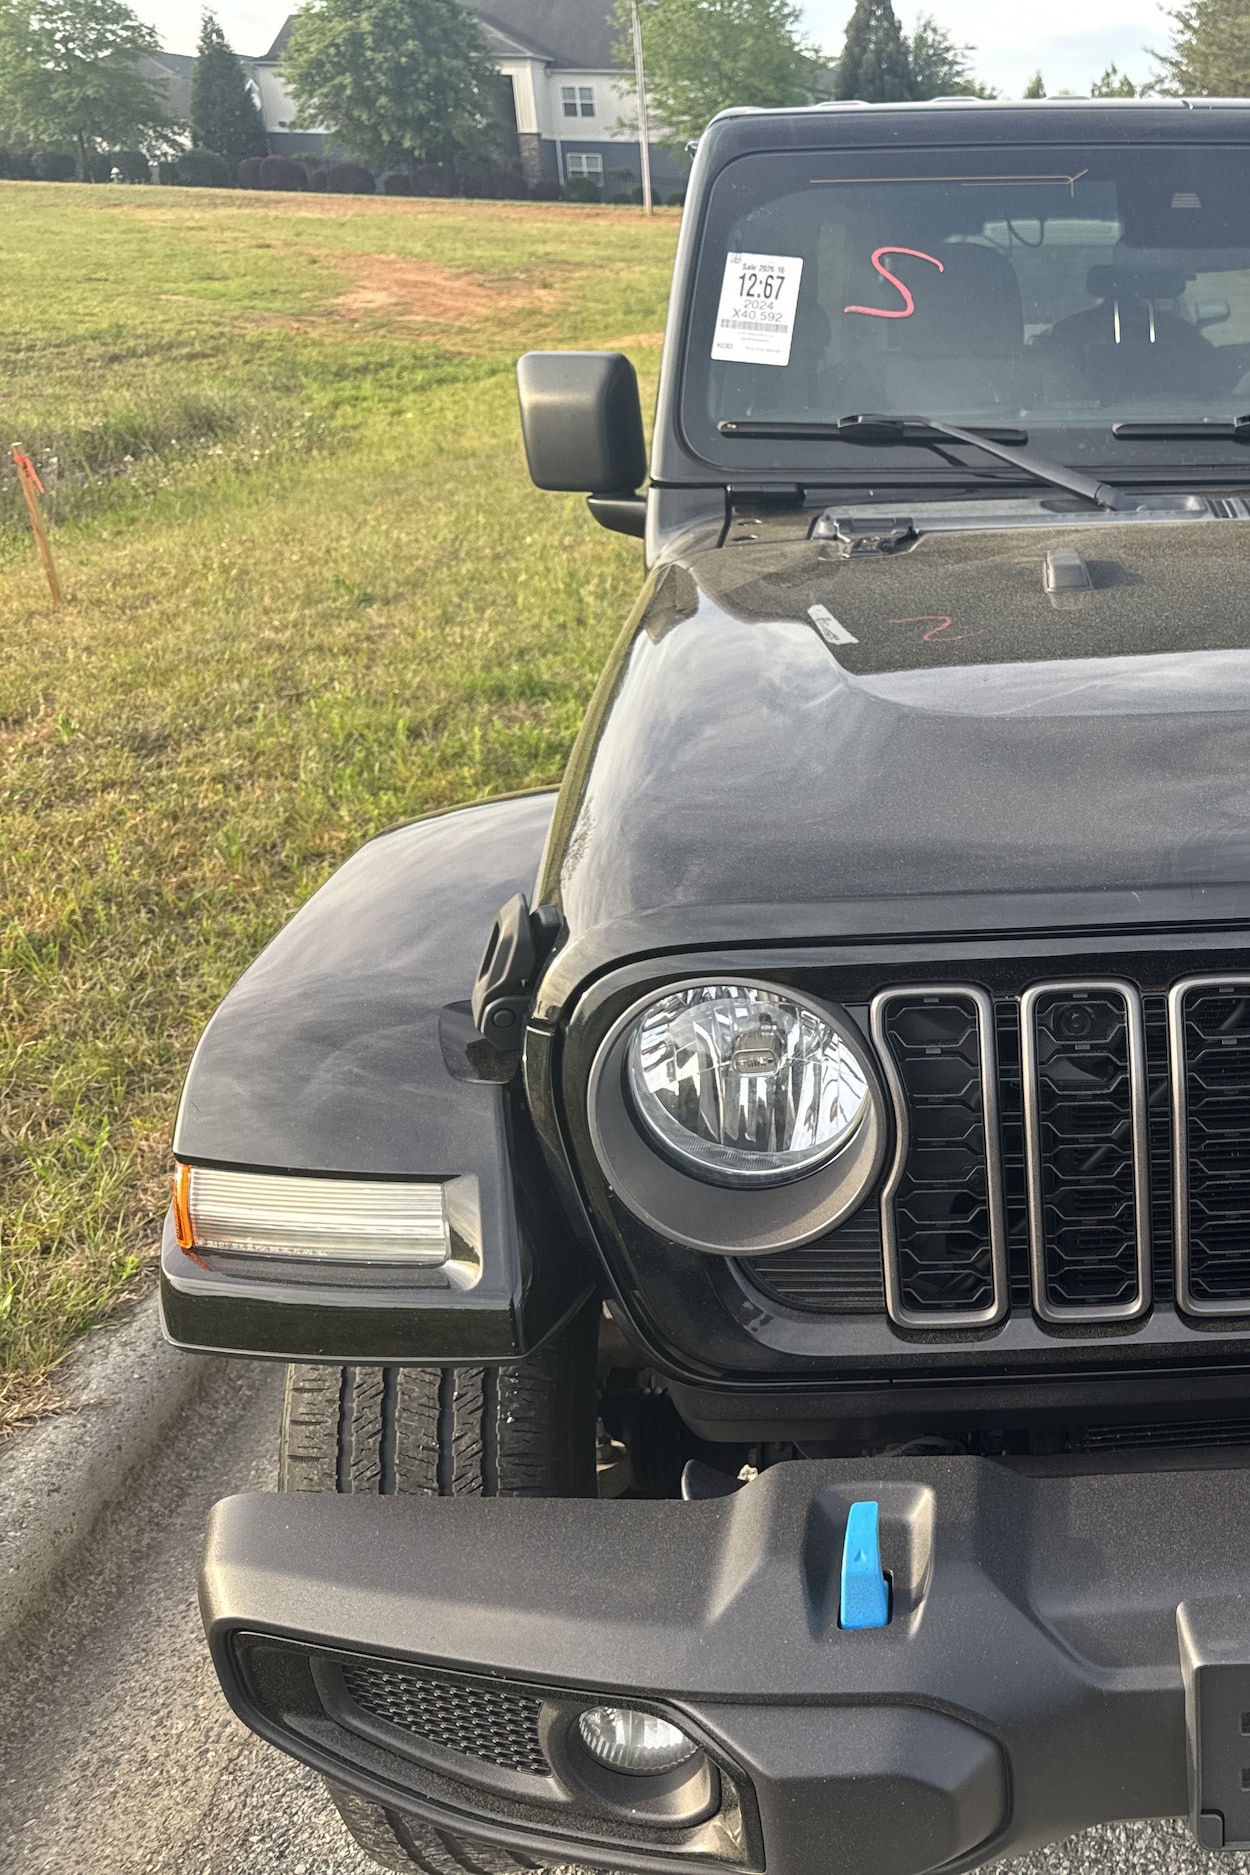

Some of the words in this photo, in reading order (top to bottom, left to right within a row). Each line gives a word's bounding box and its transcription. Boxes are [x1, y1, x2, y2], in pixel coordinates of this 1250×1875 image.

[742, 263, 757, 272] Sale
[739, 273, 785, 300] 12:67
[744, 299, 774, 311] 2024
[732, 308, 783, 323] X40,592
